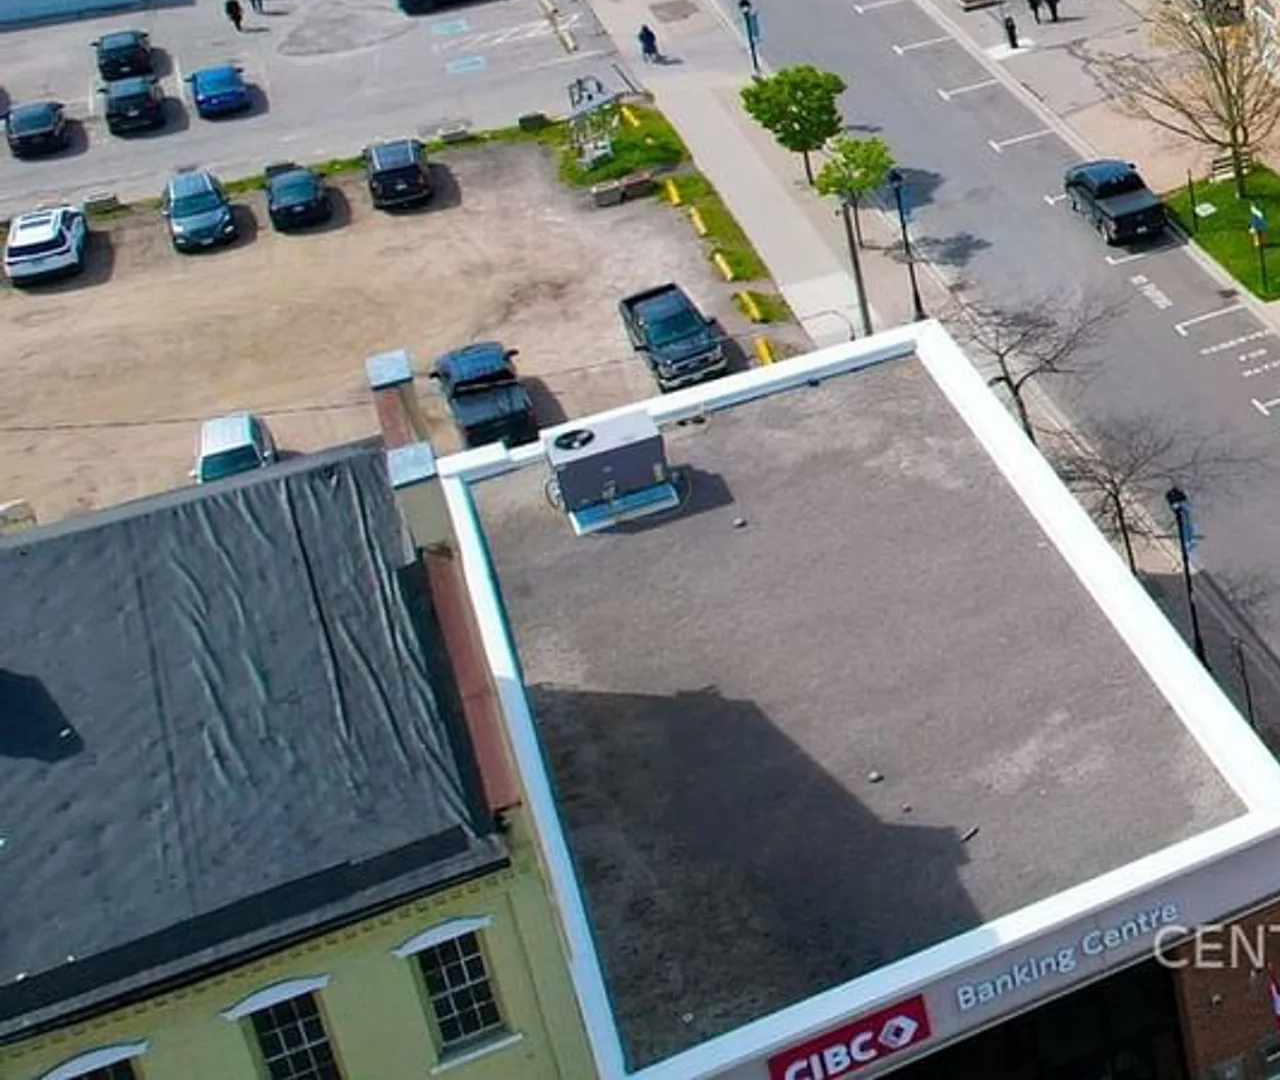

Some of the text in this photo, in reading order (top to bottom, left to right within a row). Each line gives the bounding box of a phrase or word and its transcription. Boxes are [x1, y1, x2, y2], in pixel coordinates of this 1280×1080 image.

[957, 903, 1179, 1010] Banking Centre
[784, 1031, 878, 1080] CIBC
